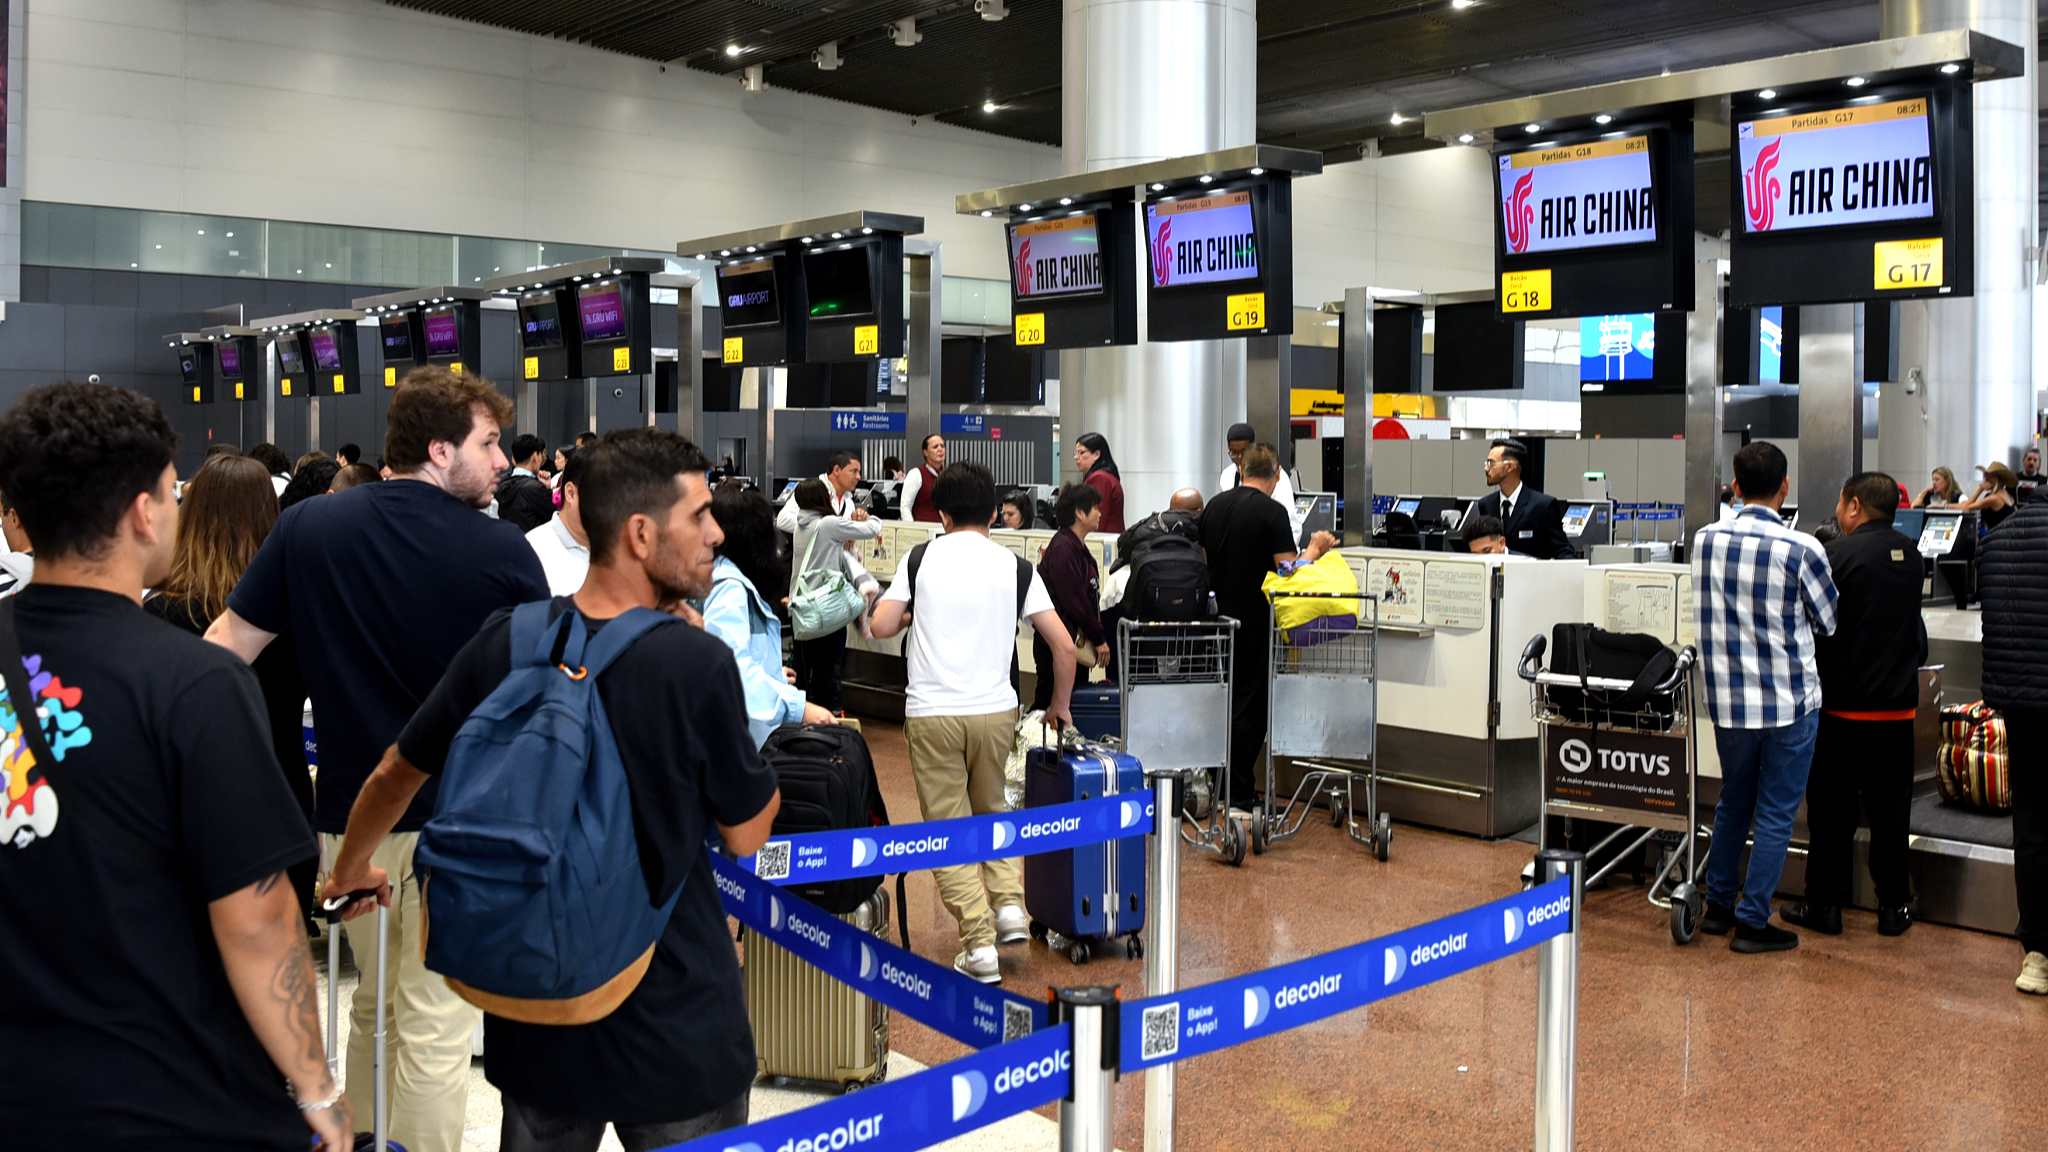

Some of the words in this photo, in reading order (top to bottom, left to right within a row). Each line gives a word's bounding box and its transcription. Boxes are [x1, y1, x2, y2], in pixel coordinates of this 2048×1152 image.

[1792, 115, 1829, 129] Partidas
[1835, 112, 1854, 124] G17
[1896, 103, 1922, 115] 08:21
[1541, 150, 1571, 162] Partidas
[1576, 147, 1592, 157] G18
[1625, 141, 1646, 150] 08:21
[1789, 166, 1834, 217] AIR
[1842, 156, 1930, 211] CHINA
[1177, 201, 1198, 211] Partidas
[1200, 199, 1212, 208] G19
[1234, 194, 1249, 204] 08:21
[1540, 195, 1577, 240] AIR
[1583, 187, 1653, 235] CHINA
[1034, 224, 1052, 232] Partidas
[1177, 241, 1203, 276] AIR
[1207, 233, 1256, 273] CHINA
[1036, 257, 1058, 291] AIR
[1060, 252, 1102, 288] CHINA
[1888, 264, 1904, 284] G
[1911, 263, 1932, 283] 17
[1506, 292, 1518, 308] G
[1522, 291, 1540, 308] 18
[1232, 311, 1242, 327] G
[1245, 311, 1259, 326] 19
[858, 341, 865, 351] G
[866, 340, 874, 351] 21
[1018, 330, 1027, 343] G
[1027, 329, 1040, 342] 20
[726, 350, 731, 361] G
[732, 350, 739, 360] 22
[862, 414, 890, 423] Sanitários
[1597, 748, 1671, 777] TOTVS
[1567, 777, 1583, 786] maior
[1584, 780, 1608, 788] empresa
[1609, 781, 1616, 789] de
[1617, 782, 1648, 793] tecnologia
[1648, 786, 1655, 794] do
[1020, 816, 1082, 839] decolar
[798, 846, 823, 857] Baixe
[881, 836, 950, 858] decolar
[797, 860, 803, 869] o
[805, 856, 827, 870] App!
[788, 912, 831, 950] decolar
[1410, 931, 1468, 967] decolar
[881, 961, 932, 1000] decolar
[1274, 972, 1342, 1009] decolar
[973, 995, 994, 1016] Baixe
[1187, 1004, 1213, 1022] Baixe
[973, 1016, 979, 1027] o
[979, 1017, 998, 1035] App!
[1186, 1026, 1194, 1038] o
[1195, 1017, 1218, 1038] App!
